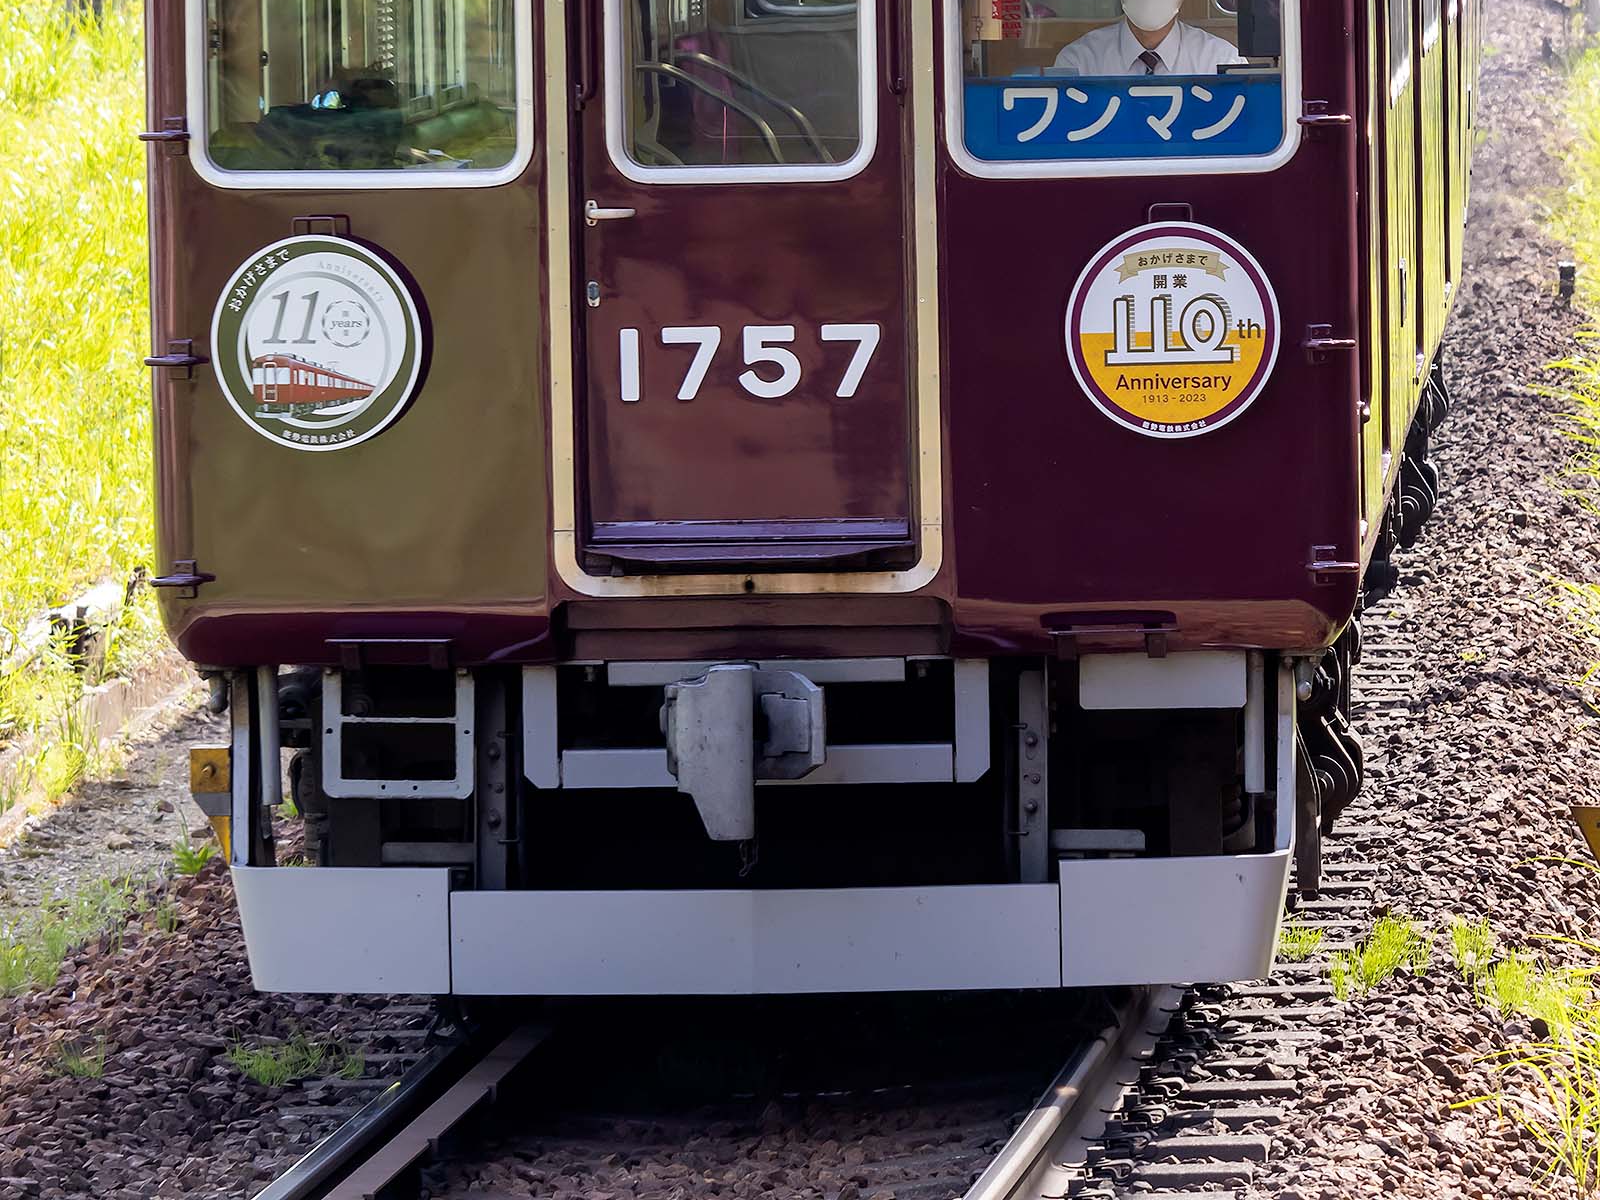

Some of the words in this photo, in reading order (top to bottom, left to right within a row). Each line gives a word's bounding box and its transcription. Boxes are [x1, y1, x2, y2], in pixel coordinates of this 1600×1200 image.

[1003, 86, 1246, 142] ワンマン
[1138, 253, 1208, 267] おかげさまで
[228, 248, 291, 312] おかげさまで
[1153, 274, 1188, 289] 開業
[620, 323, 880, 402] 1757
[1115, 373, 1232, 391] Anniversary
